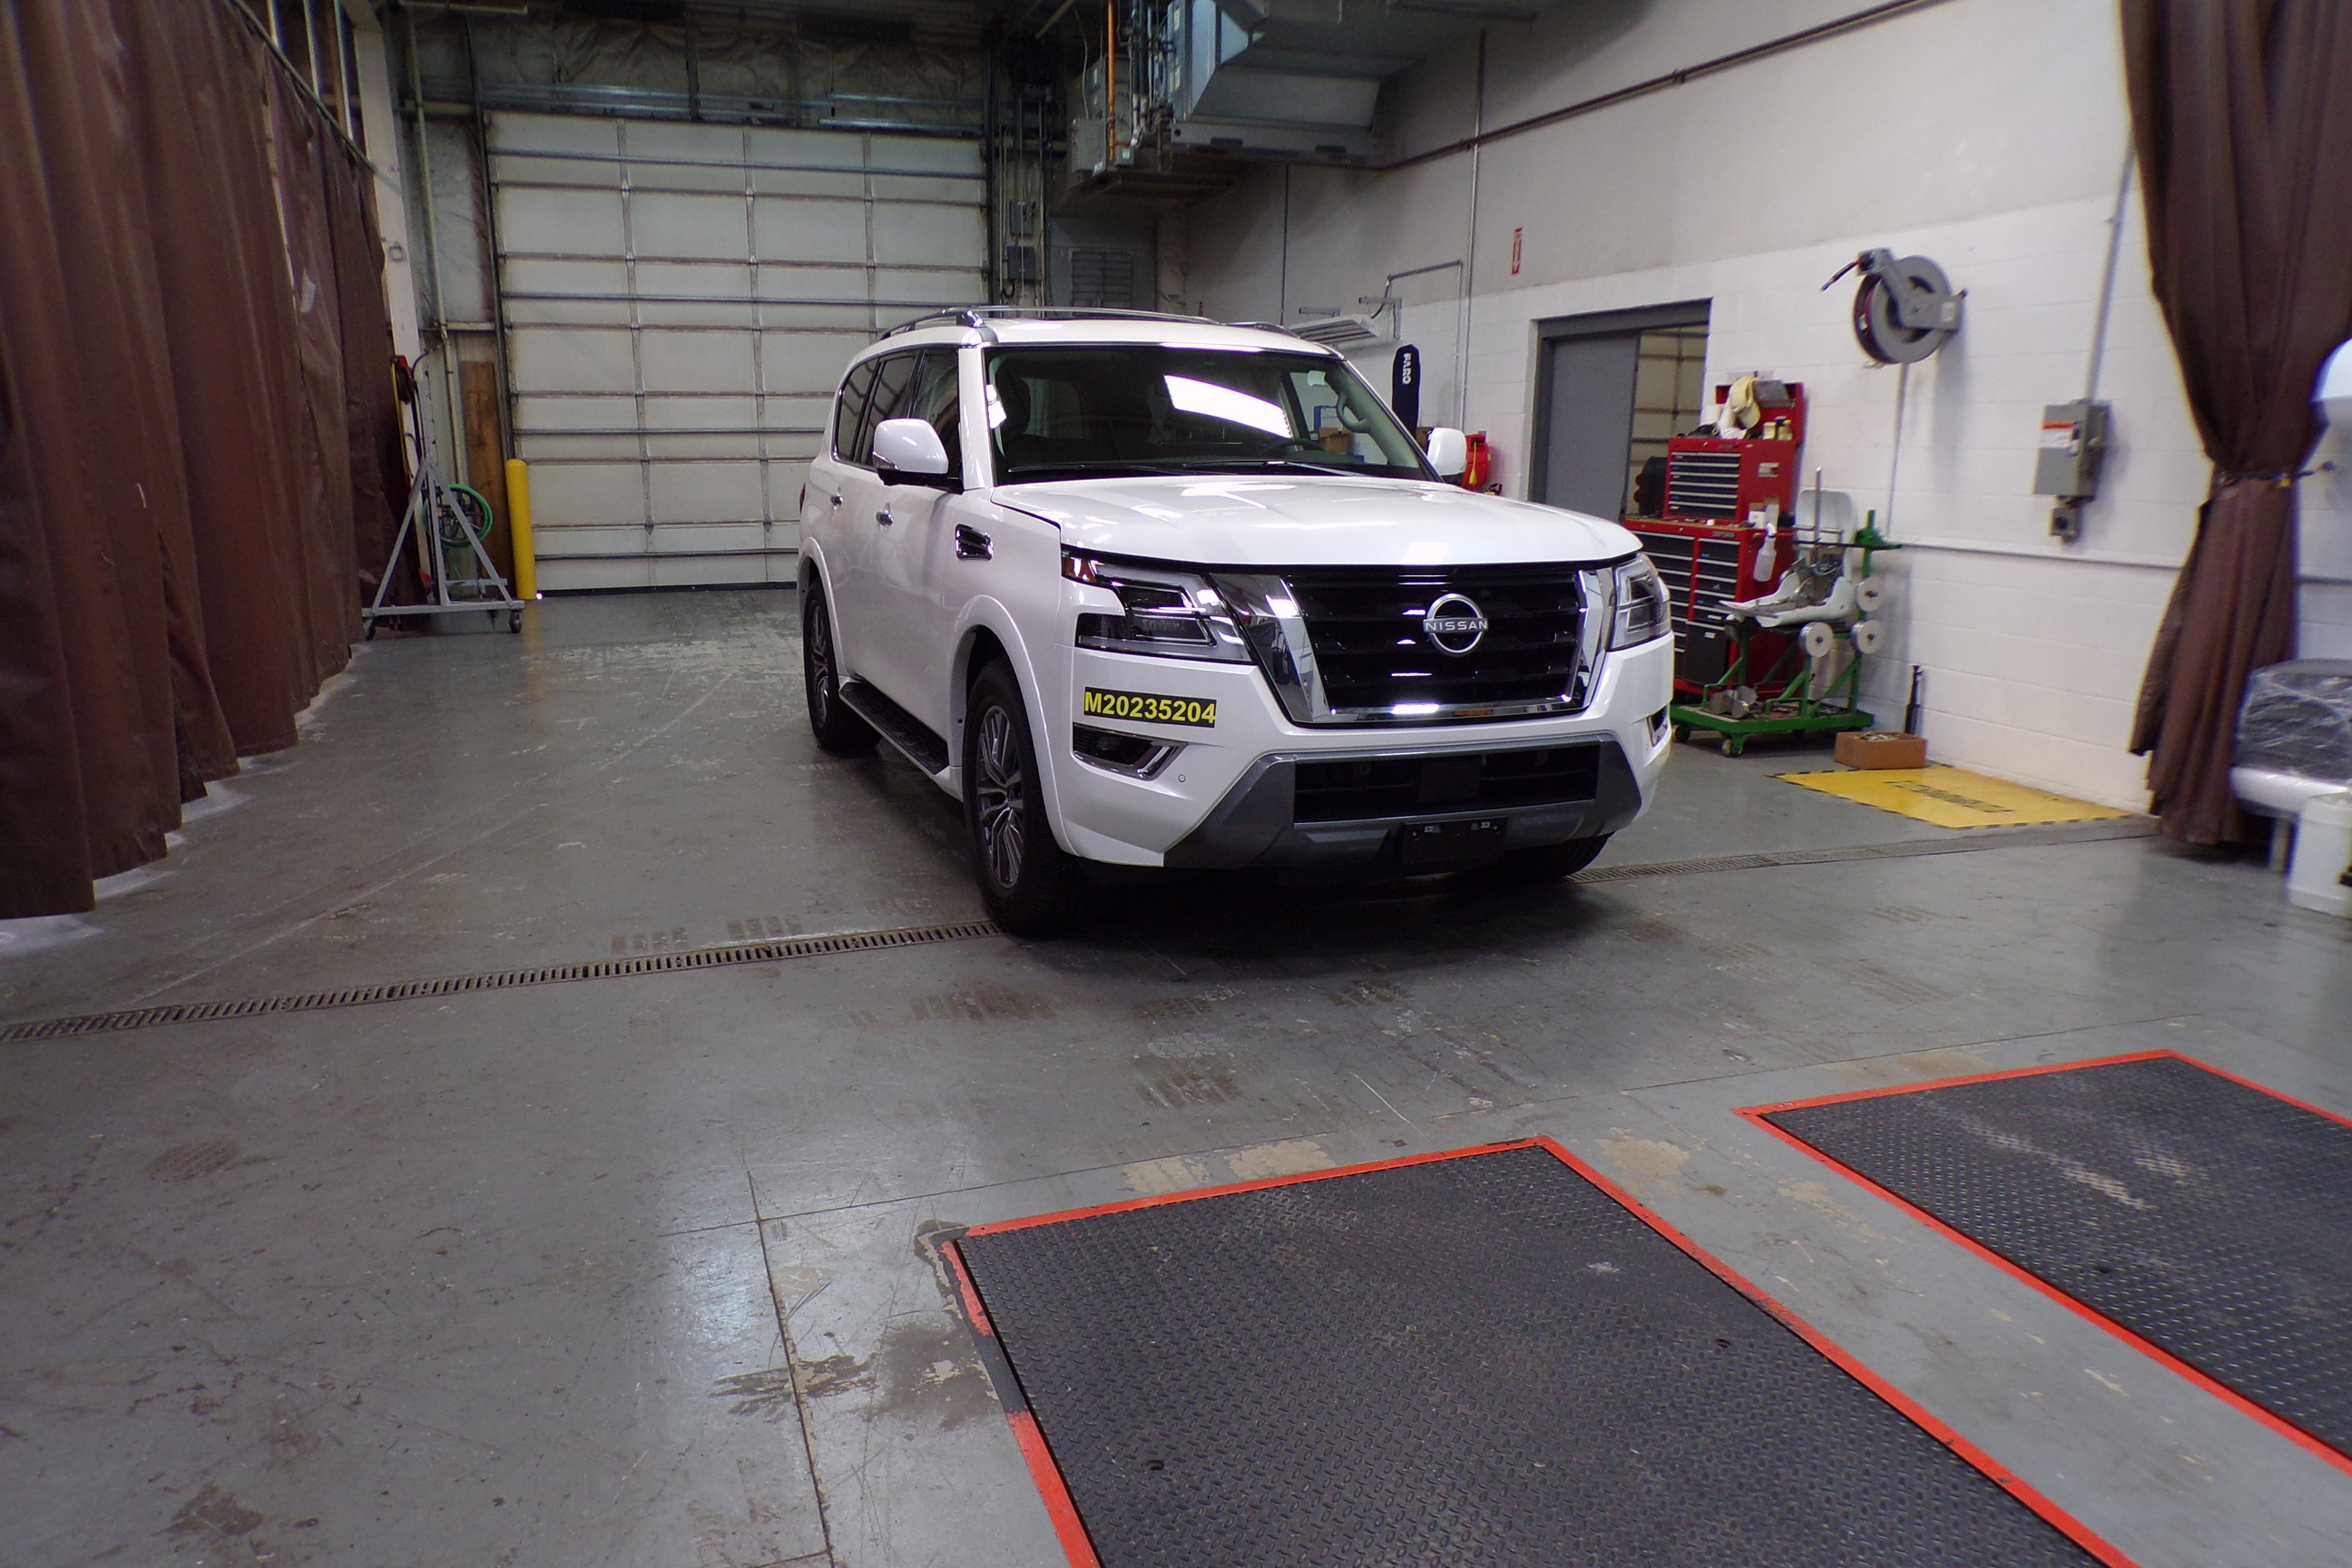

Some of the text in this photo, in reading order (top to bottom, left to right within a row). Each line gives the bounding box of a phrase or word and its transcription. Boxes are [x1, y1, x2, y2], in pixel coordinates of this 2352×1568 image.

[1402, 353, 1412, 385] FARO
[1425, 620, 1488, 632] NISSAN
[1084, 691, 1217, 724] M20235204
